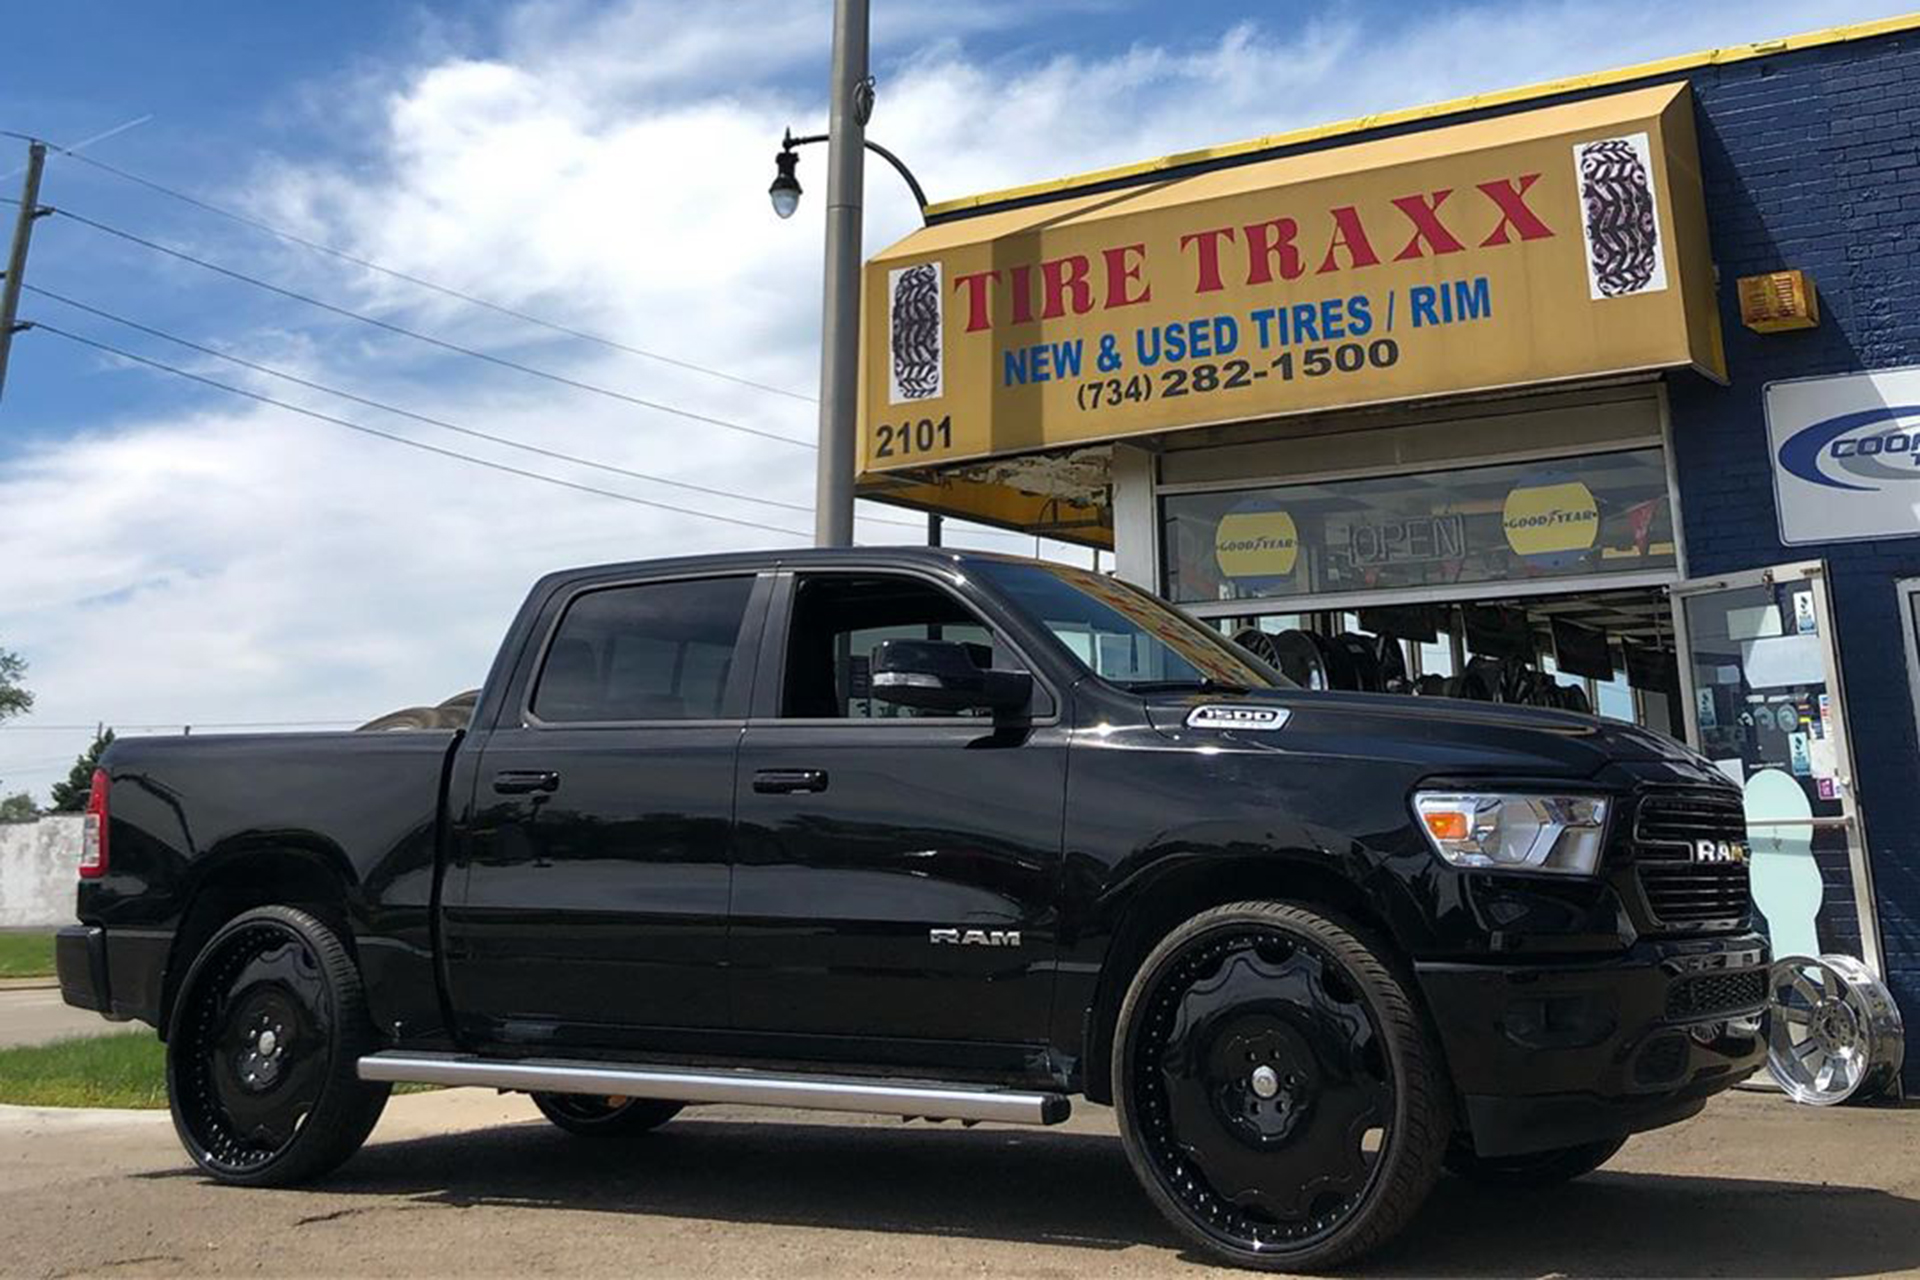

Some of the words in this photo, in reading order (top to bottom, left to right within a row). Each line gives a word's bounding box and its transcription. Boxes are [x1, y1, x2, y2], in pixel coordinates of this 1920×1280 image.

[954, 243, 1151, 333] TIRE
[1180, 173, 1556, 294] TRAXX
[1003, 339, 1083, 387] NEW
[1097, 334, 1123, 374] &
[1136, 315, 1239, 367] USED
[1251, 294, 1373, 349] TIRES
[1387, 290, 1395, 333] /
[1410, 277, 1491, 328] RIM
[1077, 373, 1152, 411] (734)
[1161, 338, 1399, 399] 282-1500
[875, 415, 952, 459] 2101
[1352, 518, 1459, 560] OPEN
[1206, 709, 1274, 722] 1500
[929, 928, 1021, 947] RAM
